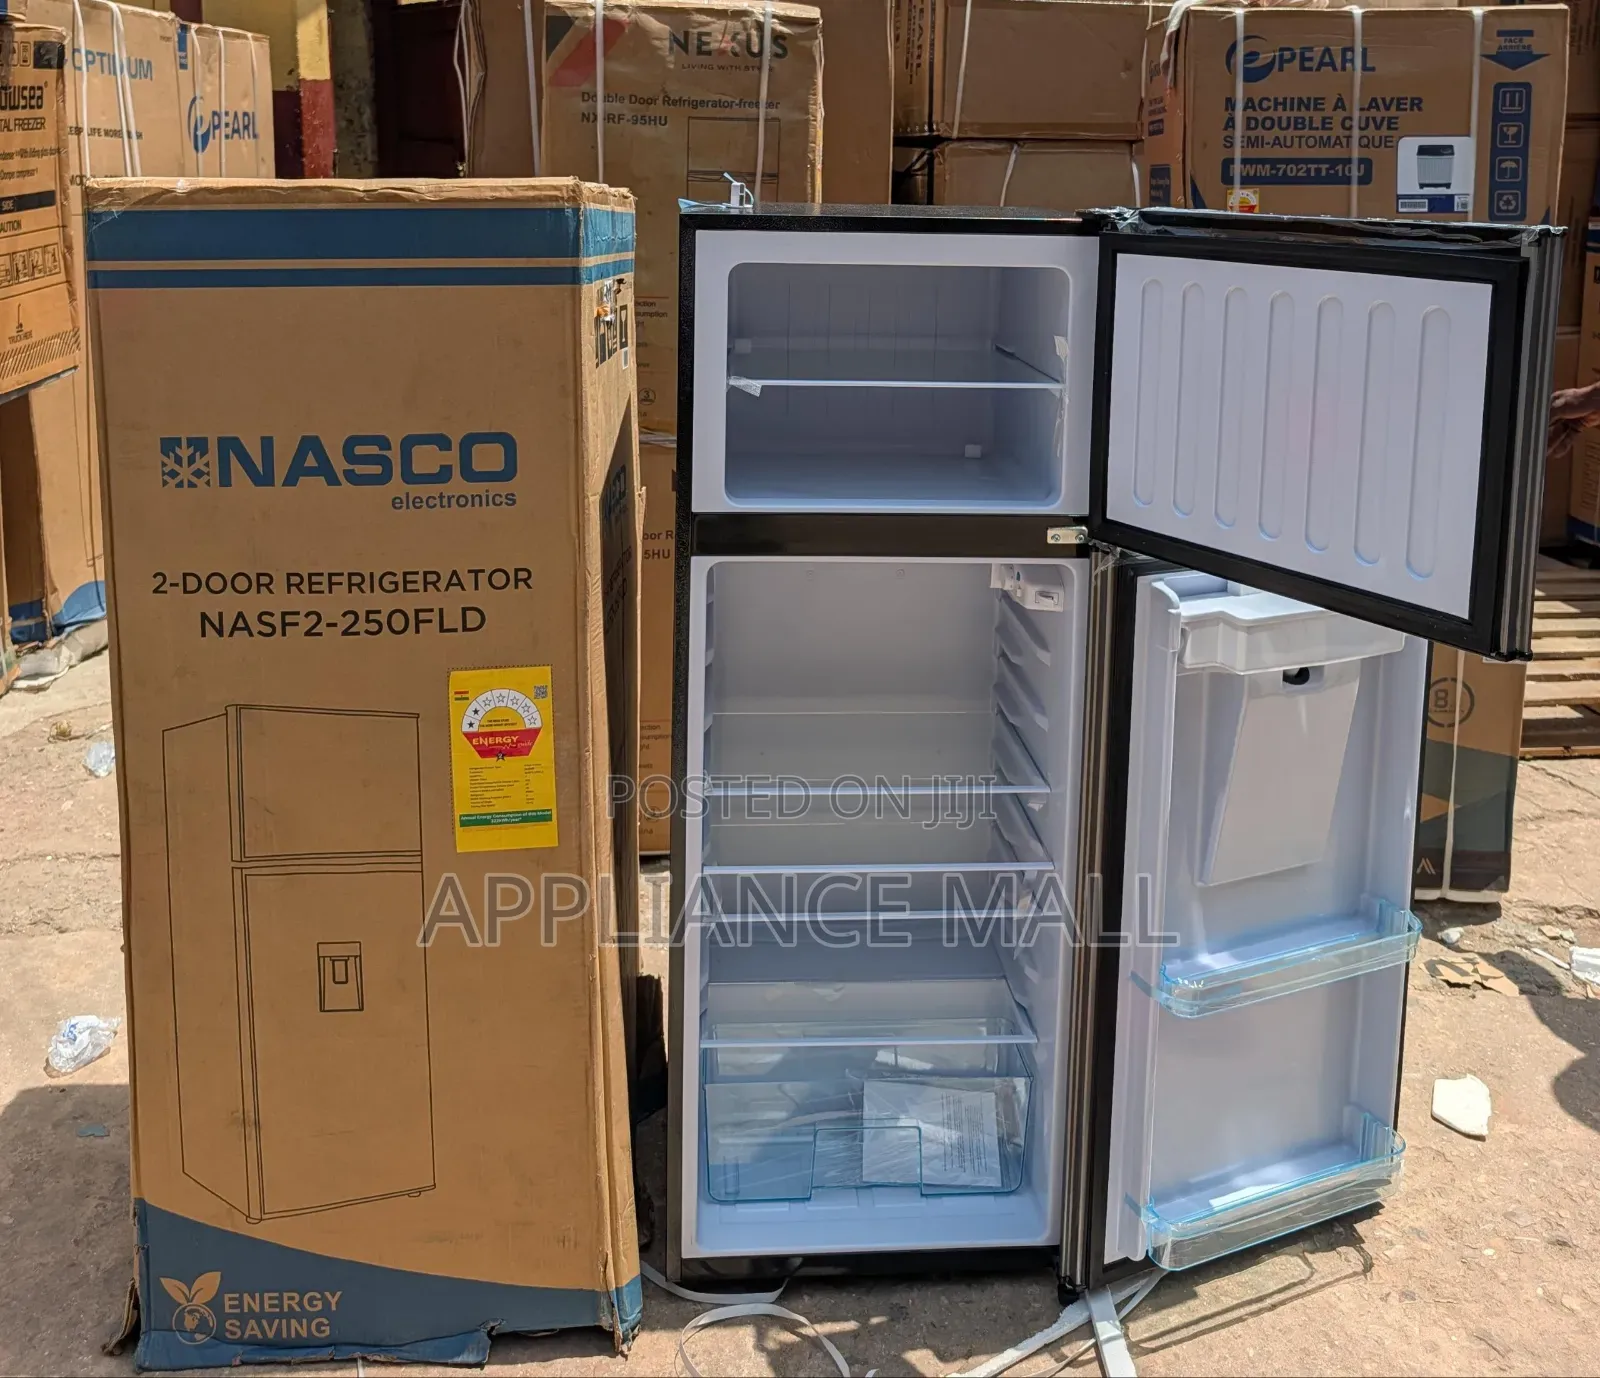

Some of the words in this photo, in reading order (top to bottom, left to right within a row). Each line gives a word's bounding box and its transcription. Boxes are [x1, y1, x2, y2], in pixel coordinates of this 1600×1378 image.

[668, 30, 789, 59] NEXUS
[681, 63, 714, 71] LIVING
[717, 64, 741, 72] WITH
[744, 65, 774, 73] STYE
[1277, 46, 1376, 73] PEARL
[629, 94, 659, 106] Door
[1224, 97, 1326, 112] MACHINE
[1332, 93, 1347, 112] À
[14, 117, 46, 132] FREEZER
[212, 110, 258, 140] PEARL
[1222, 113, 1236, 131] À
[1246, 116, 1334, 131] DOUBLE
[1340, 116, 1400, 131] CUVE
[1222, 135, 1394, 149] SEMI-AUTOMATQUE
[216, 431, 518, 488] NASCO
[391, 489, 517, 511] electronics
[151, 571, 275, 596] 2-DOOR
[286, 567, 533, 595] REFRIGERATOR
[200, 605, 487, 638] NASF2-250FLD
[472, 735, 519, 748] ENERGY
[224, 1291, 343, 1313] ENERGY
[224, 1318, 331, 1340] SAVING
